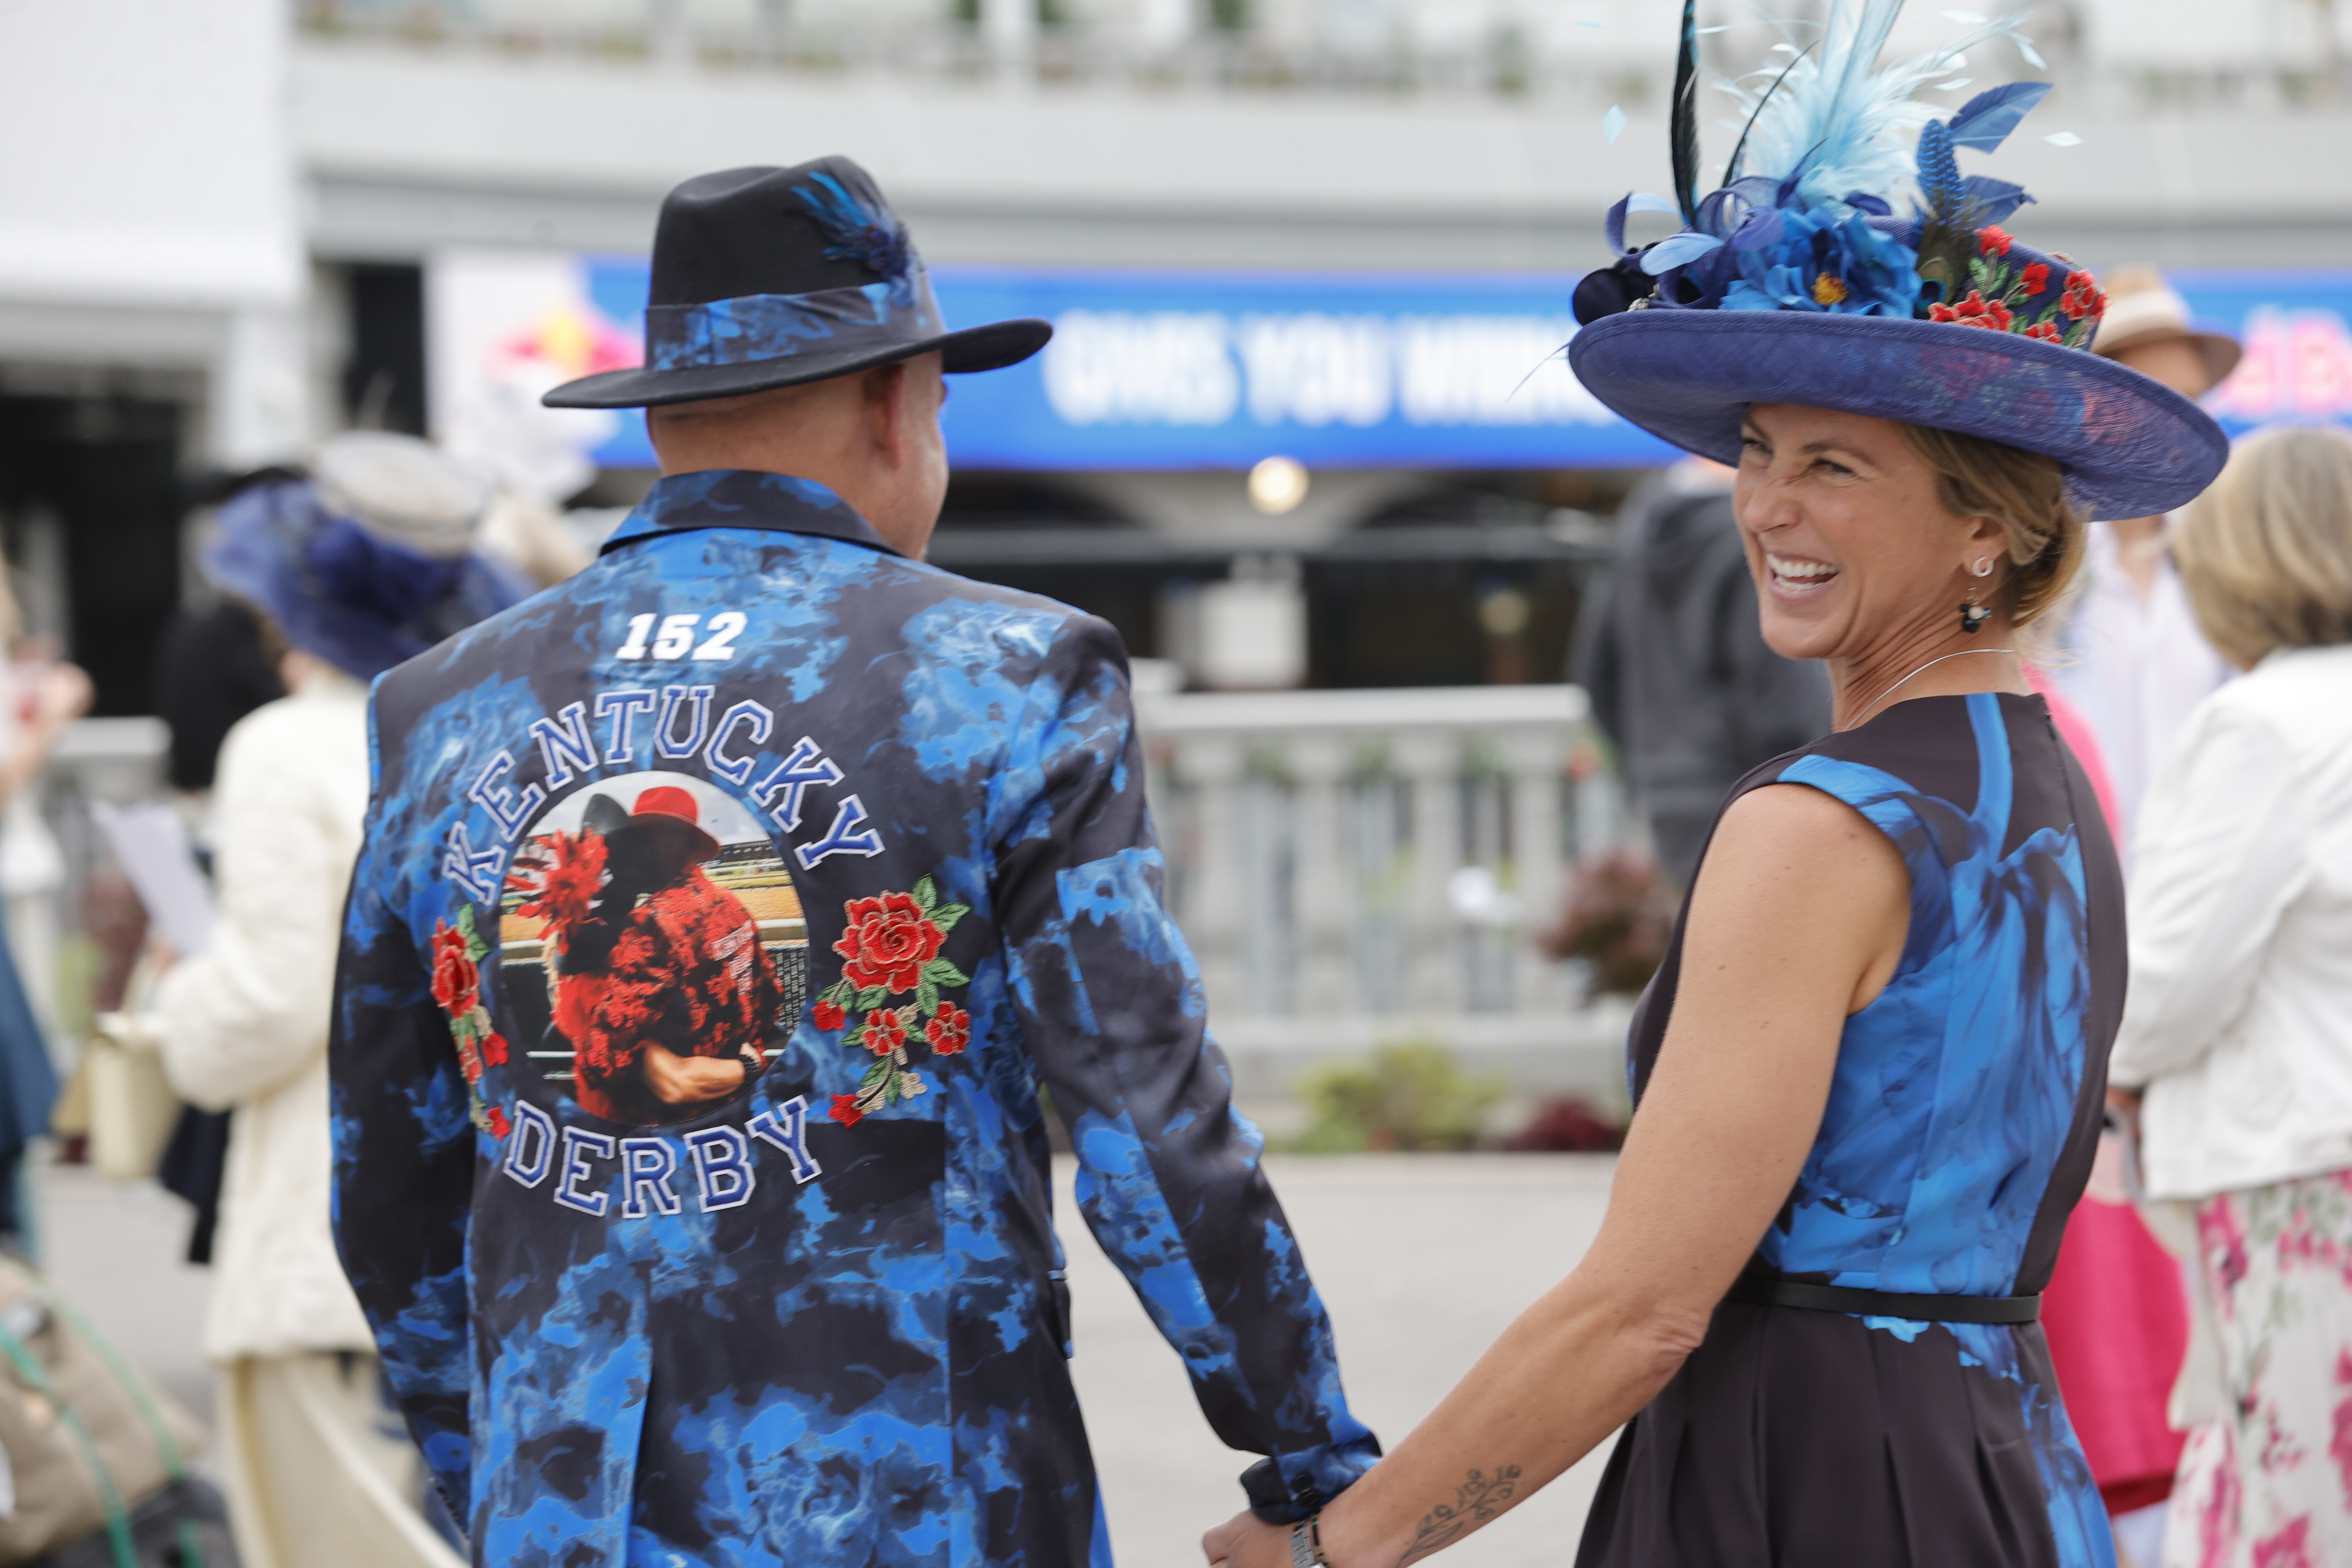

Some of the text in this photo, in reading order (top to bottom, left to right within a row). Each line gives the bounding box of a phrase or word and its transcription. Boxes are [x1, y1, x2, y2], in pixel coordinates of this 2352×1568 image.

[615, 612, 748, 660] 152
[442, 685, 885, 906] KENTUCKY
[503, 1095, 822, 1219] DERBY
